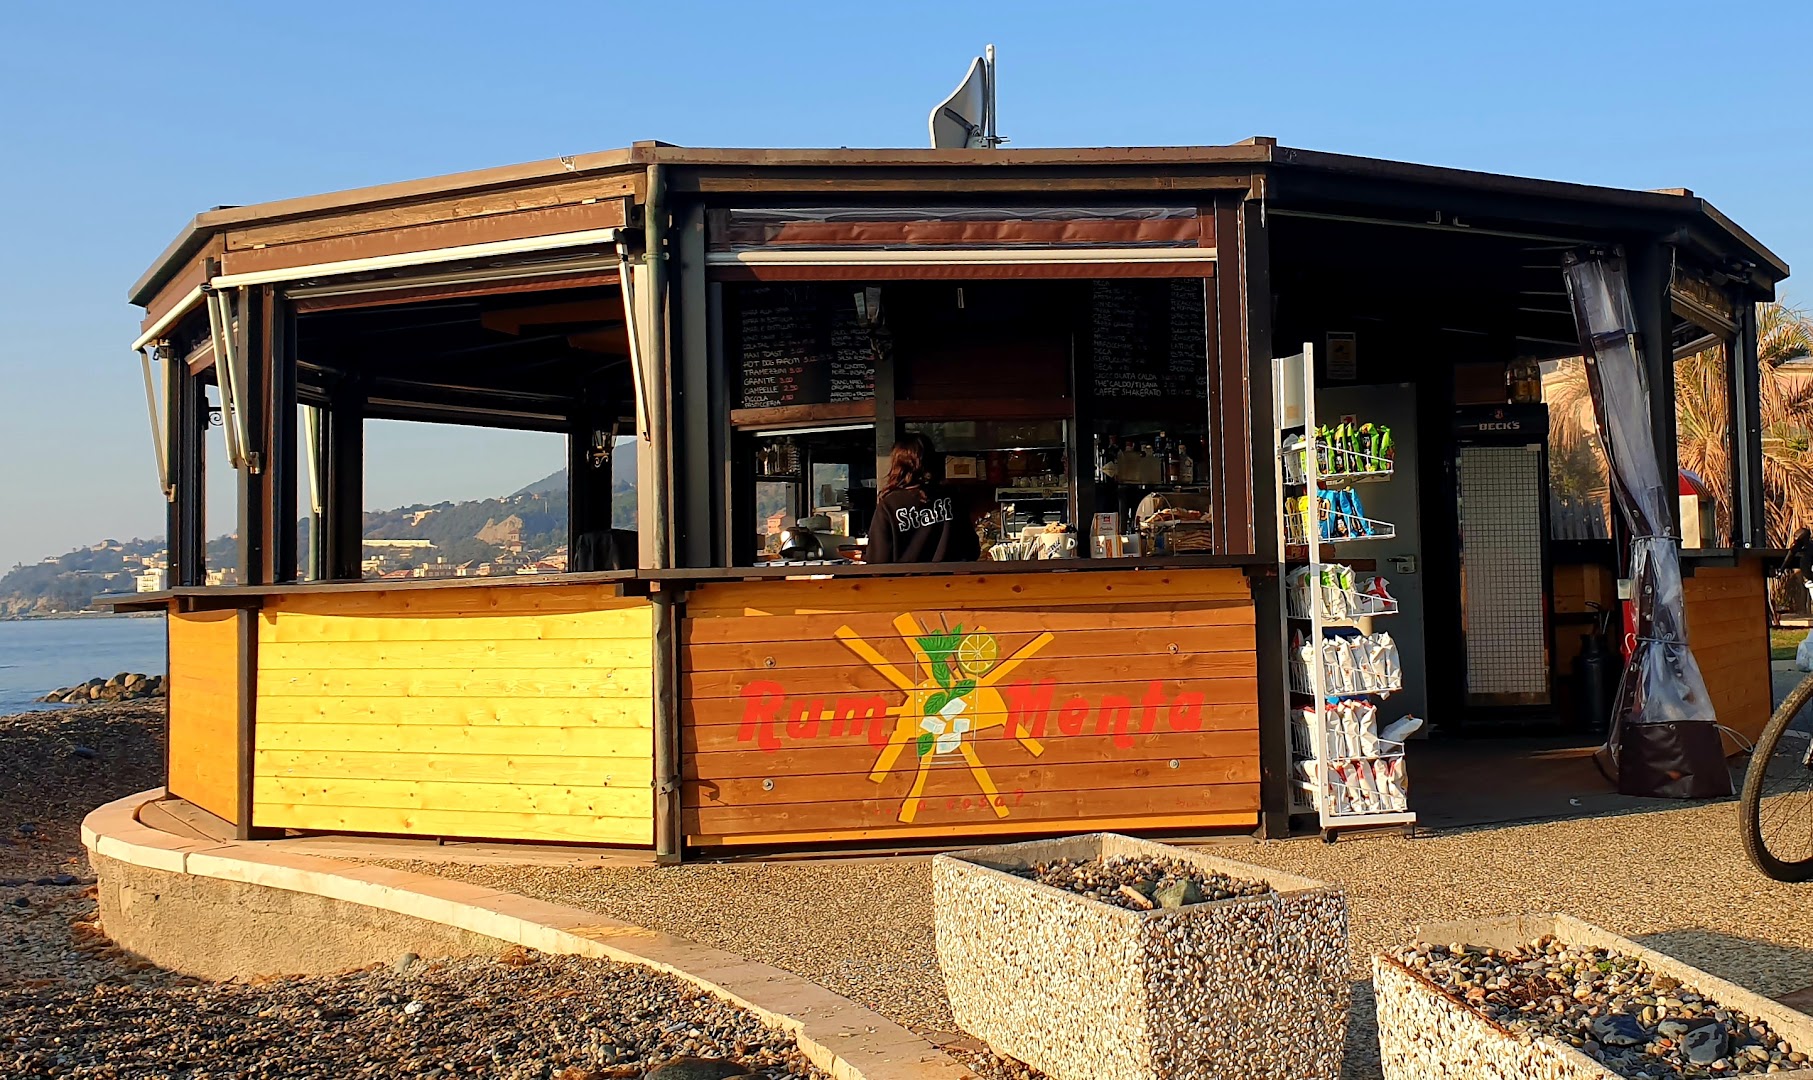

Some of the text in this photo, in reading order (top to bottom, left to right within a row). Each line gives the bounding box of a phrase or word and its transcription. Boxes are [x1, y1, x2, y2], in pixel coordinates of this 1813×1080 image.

[761, 350, 784, 358] TOAST
[742, 360, 760, 368] HOT
[743, 377, 776, 386] GRANITE
[1121, 388, 1162, 398] SHAKERATO
[1478, 421, 1521, 431] BECK'S
[895, 497, 954, 532] Staff
[737, 677, 1204, 755] Rum Menta
